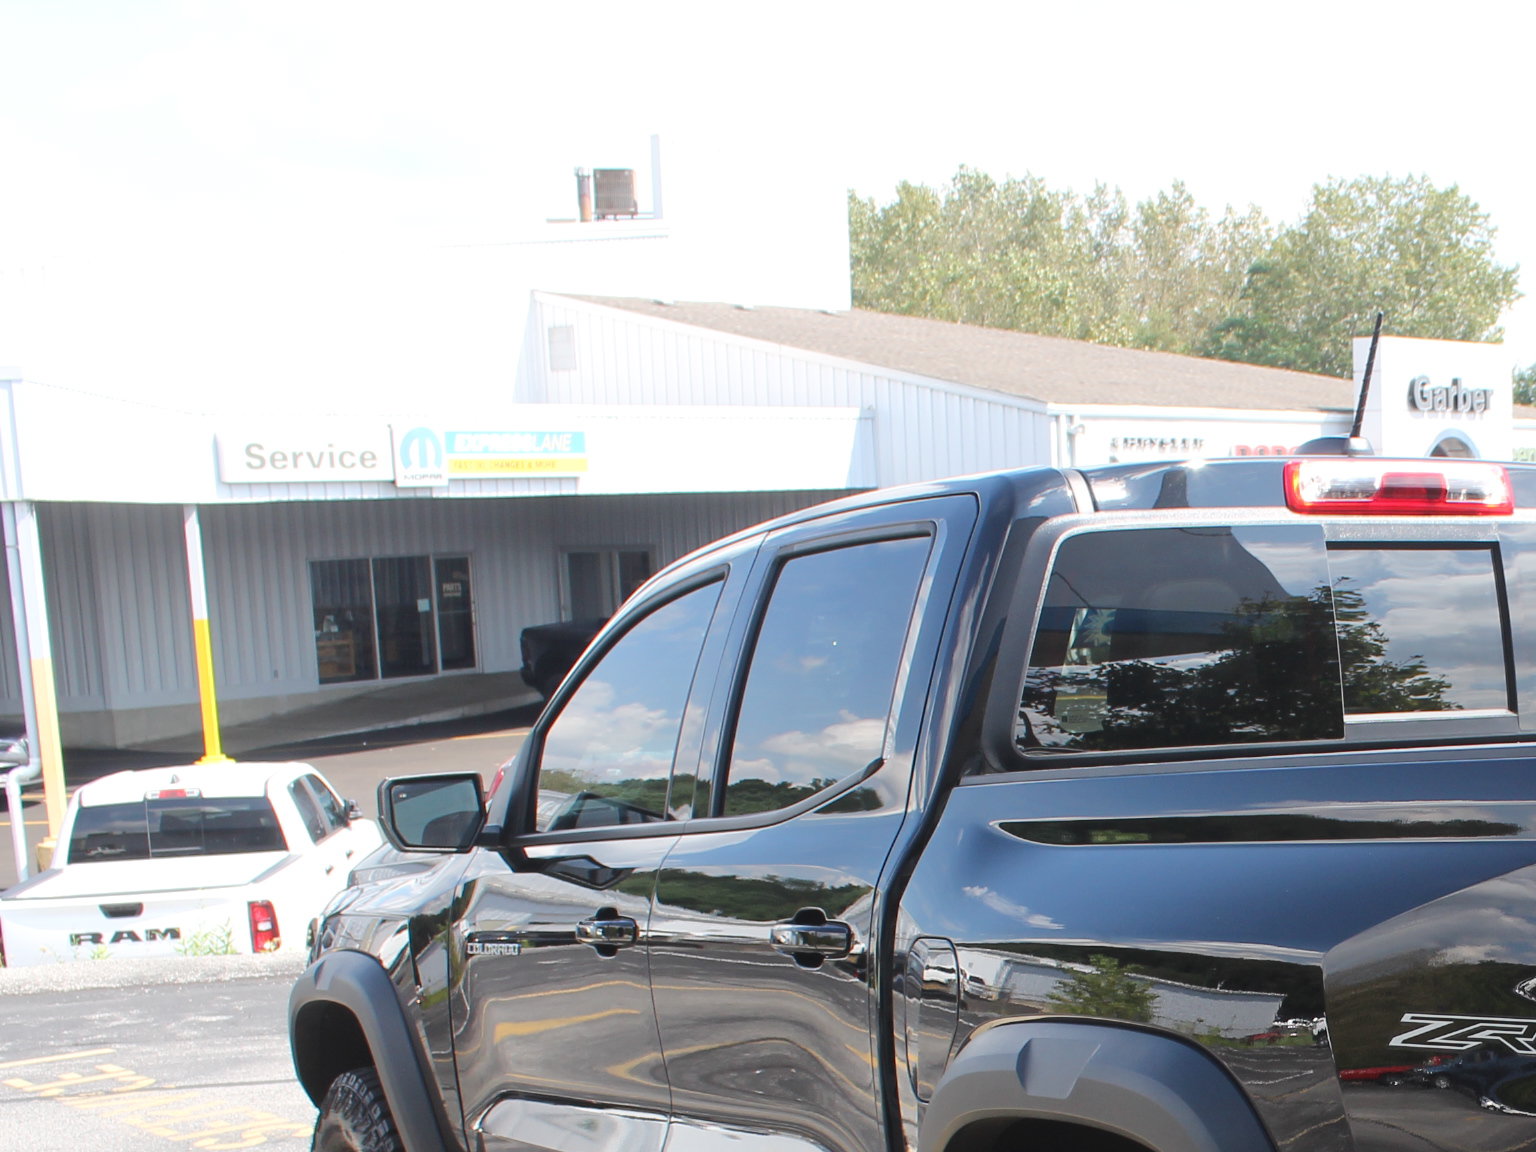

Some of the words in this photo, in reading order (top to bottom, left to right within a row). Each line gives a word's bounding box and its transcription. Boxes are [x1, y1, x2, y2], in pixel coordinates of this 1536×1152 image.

[1408, 374, 1493, 414] Garber
[245, 442, 378, 471] Service
[69, 927, 181, 946] RAM
[467, 942, 520, 955] COLORADO
